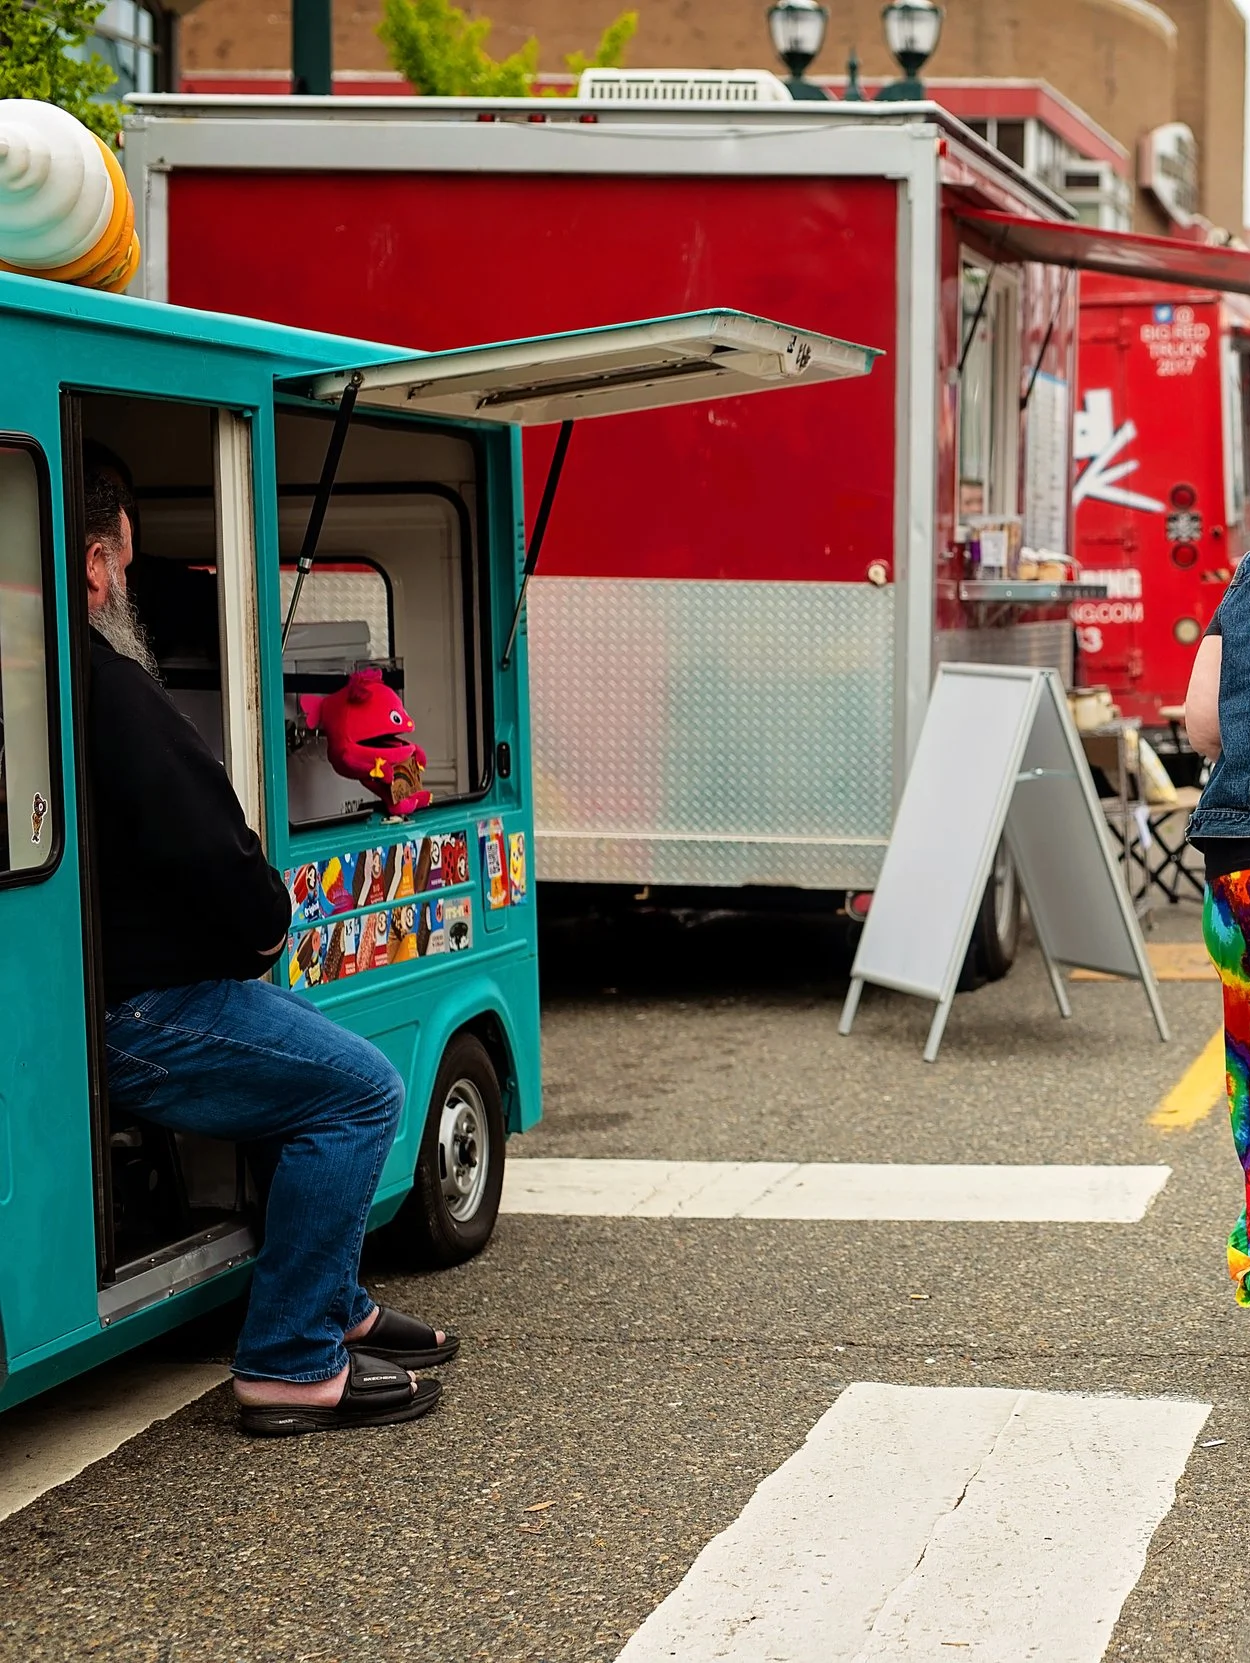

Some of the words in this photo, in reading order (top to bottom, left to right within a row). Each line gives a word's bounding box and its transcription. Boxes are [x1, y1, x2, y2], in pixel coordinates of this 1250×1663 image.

[1140, 324, 1171, 343] BIG
[1172, 323, 1210, 341] RED
[1147, 341, 1206, 358] TRUCK
[1156, 358, 1196, 376] 2017
